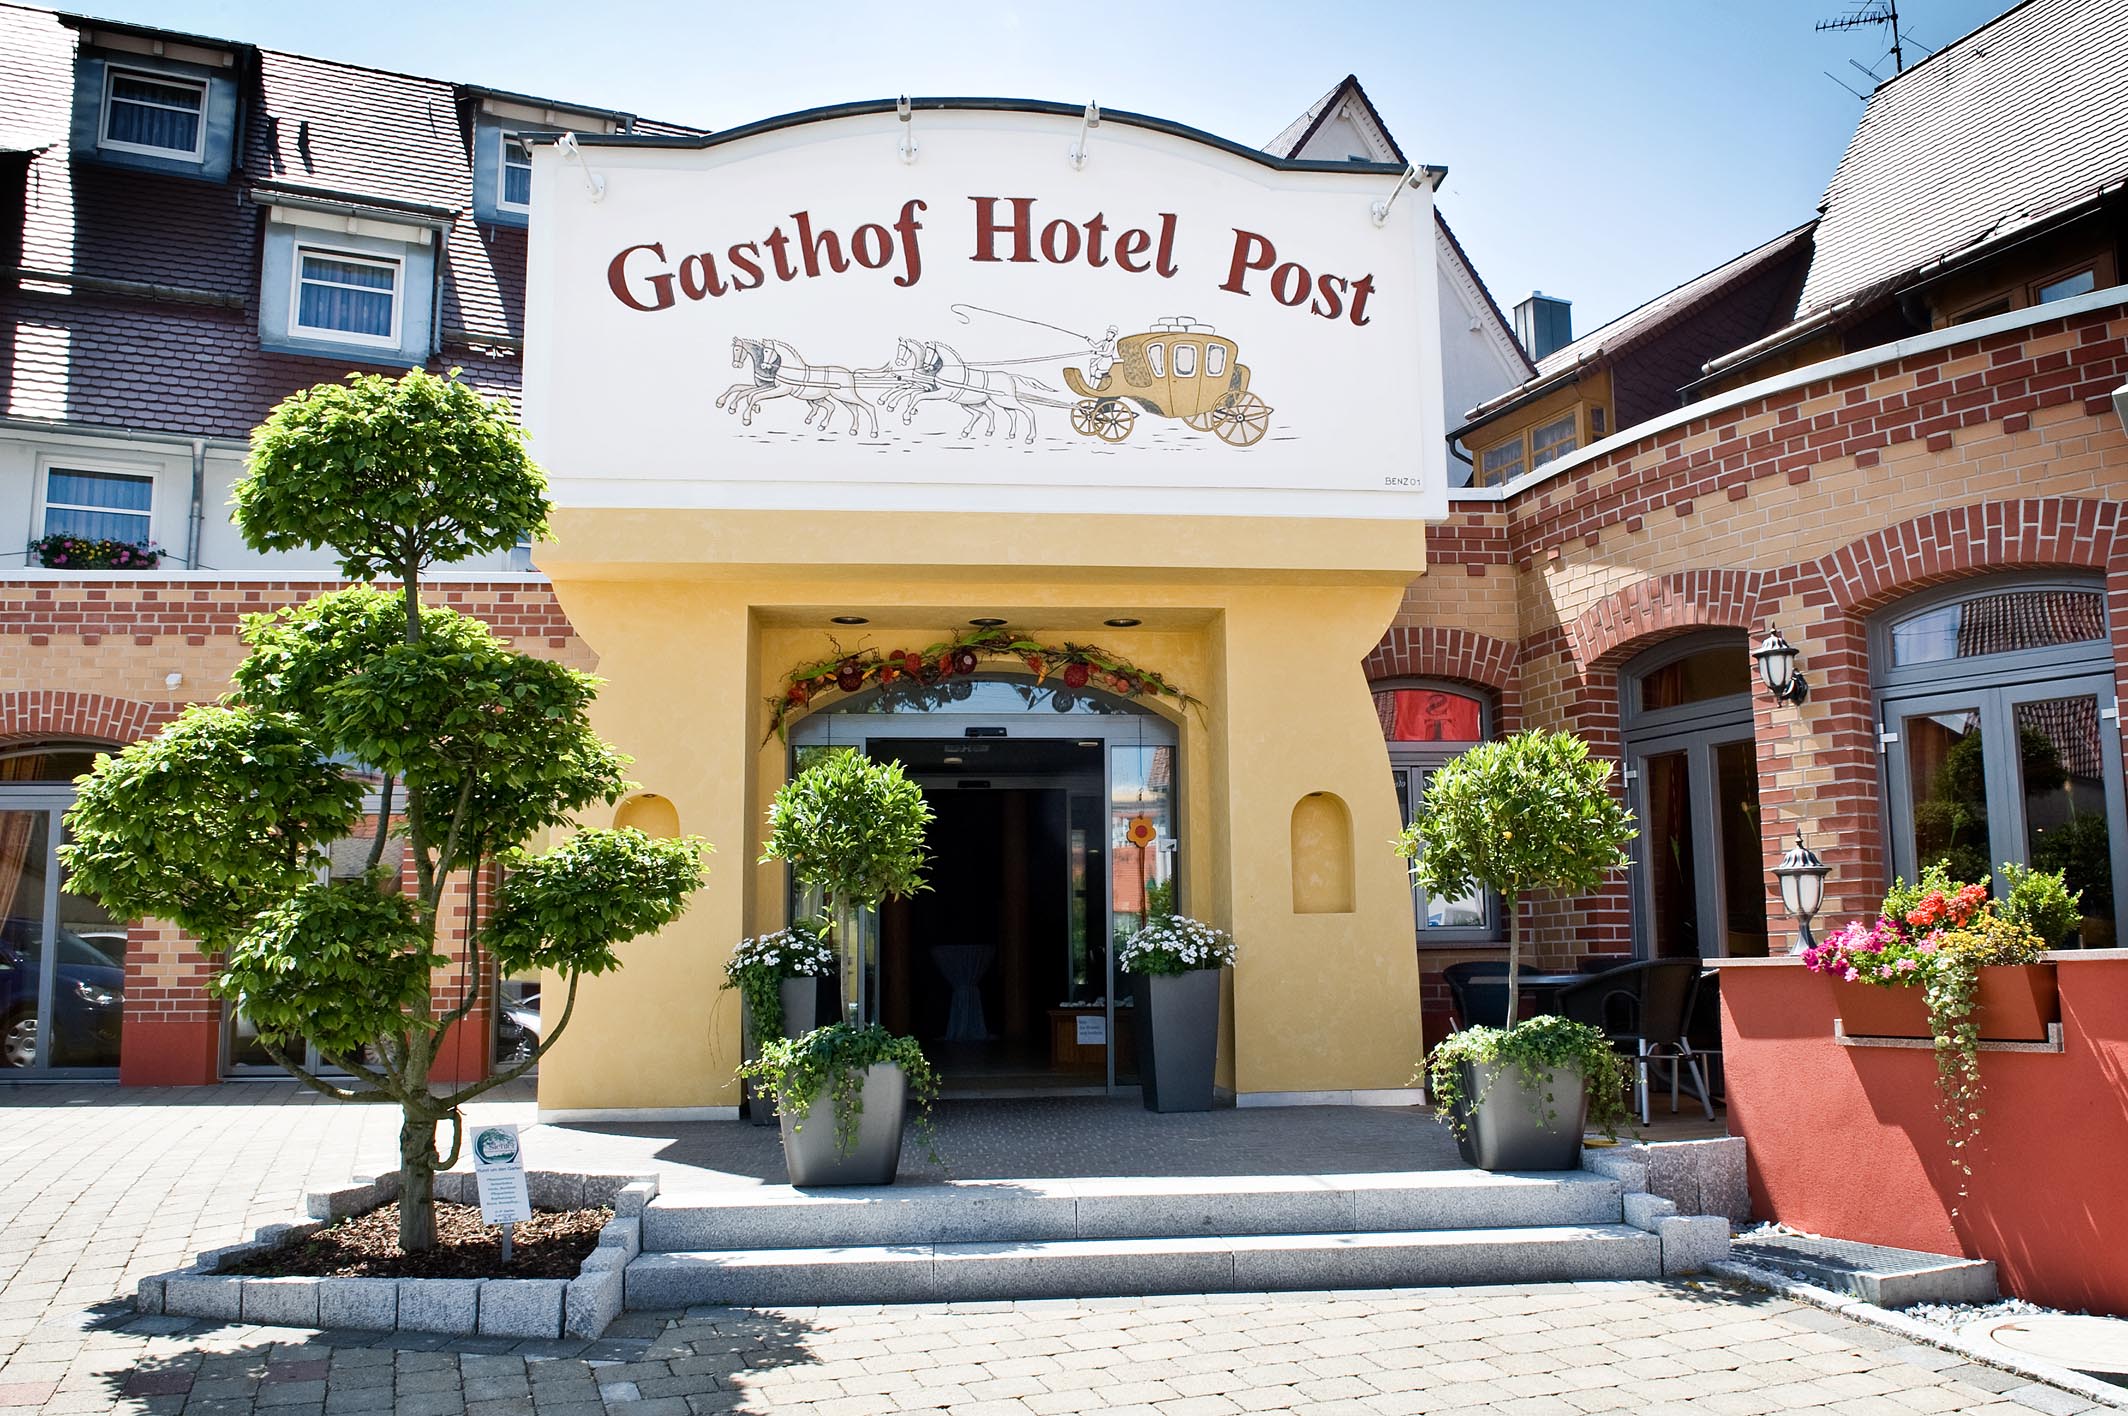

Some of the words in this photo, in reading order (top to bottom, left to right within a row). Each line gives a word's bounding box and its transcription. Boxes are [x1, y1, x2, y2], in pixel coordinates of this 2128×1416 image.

[607, 199, 927, 312] Gasthof
[967, 196, 1179, 279] Hotel
[1218, 227, 1376, 327] Post
